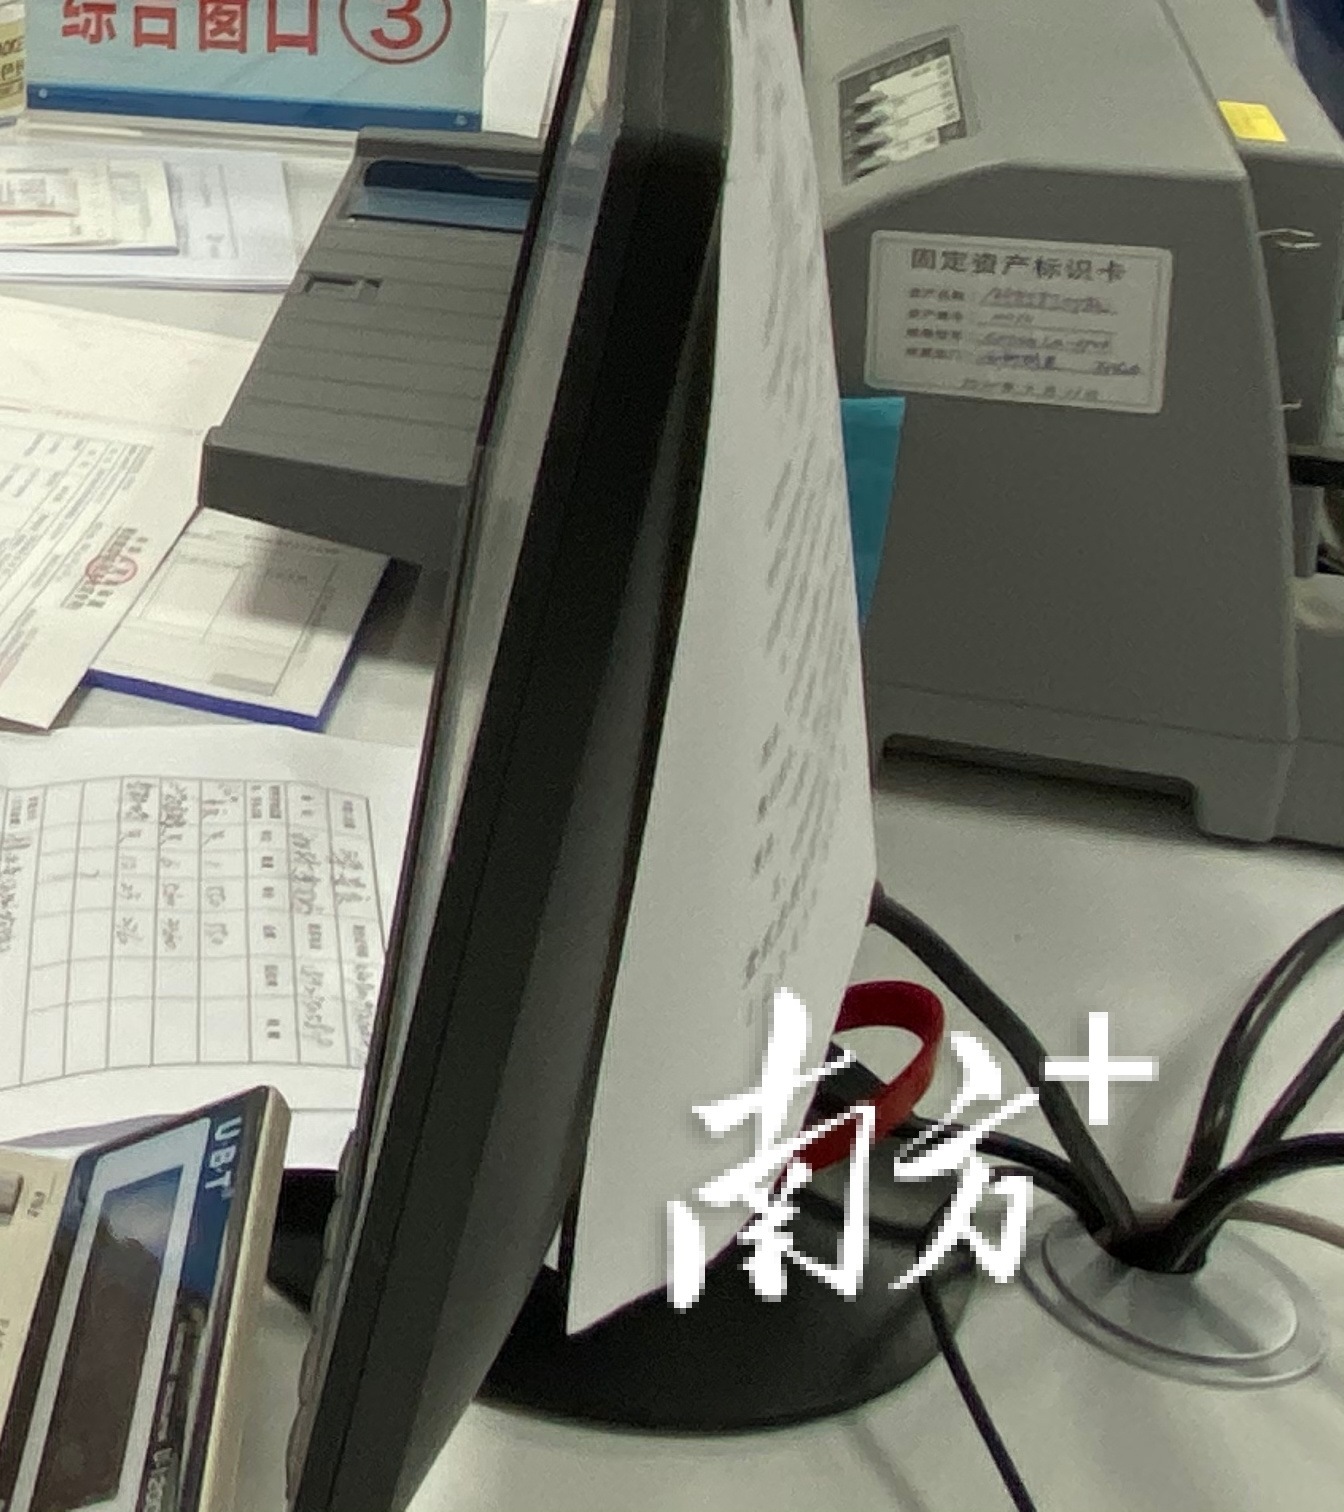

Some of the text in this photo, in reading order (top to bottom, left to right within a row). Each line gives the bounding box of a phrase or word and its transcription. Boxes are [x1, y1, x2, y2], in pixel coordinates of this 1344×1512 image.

[910, 247, 1127, 284] 固定资产标识卡
